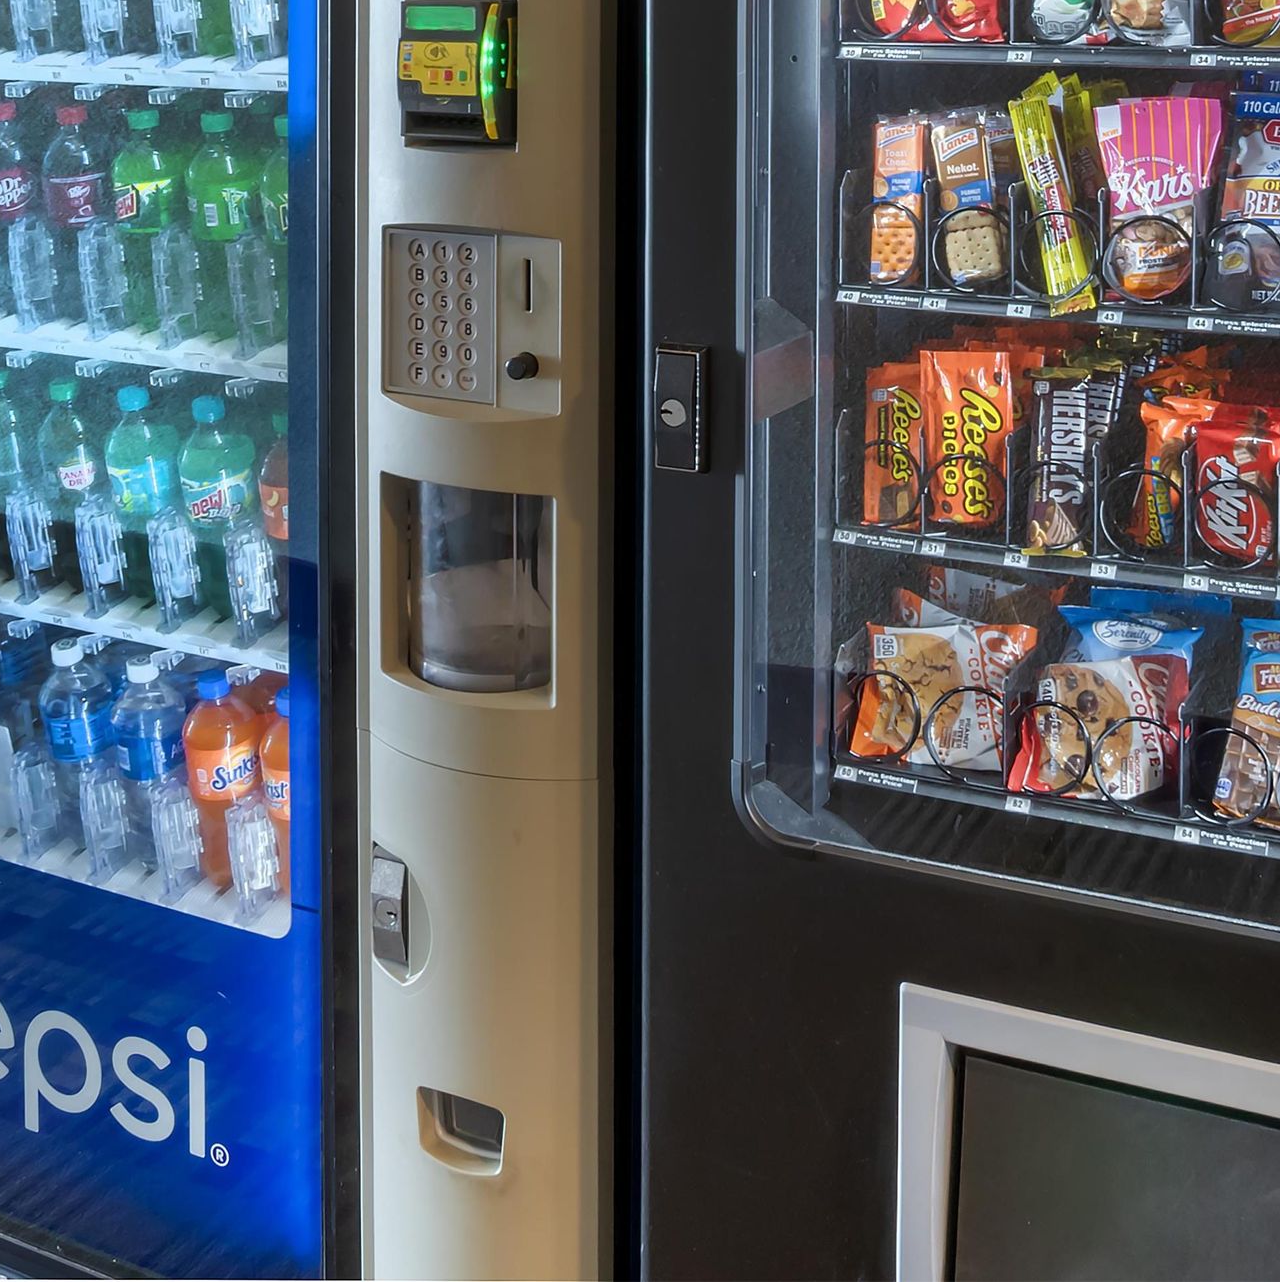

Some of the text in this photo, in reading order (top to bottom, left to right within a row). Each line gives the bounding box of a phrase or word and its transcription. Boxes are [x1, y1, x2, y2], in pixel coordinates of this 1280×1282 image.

[941, 131, 974, 154] Lance
[1243, 101, 1261, 114] 110
[1, 177, 21, 194] Dr
[1195, 319, 1206, 328] 44
[893, 389, 921, 483] Reese's
[942, 414, 958, 496] pieces
[960, 388, 1003, 518] Reese's
[1050, 390, 1087, 506] HERSHEY'S
[969, 657, 989, 732] COOKIE
[1130, 690, 1161, 769] COOKIE
